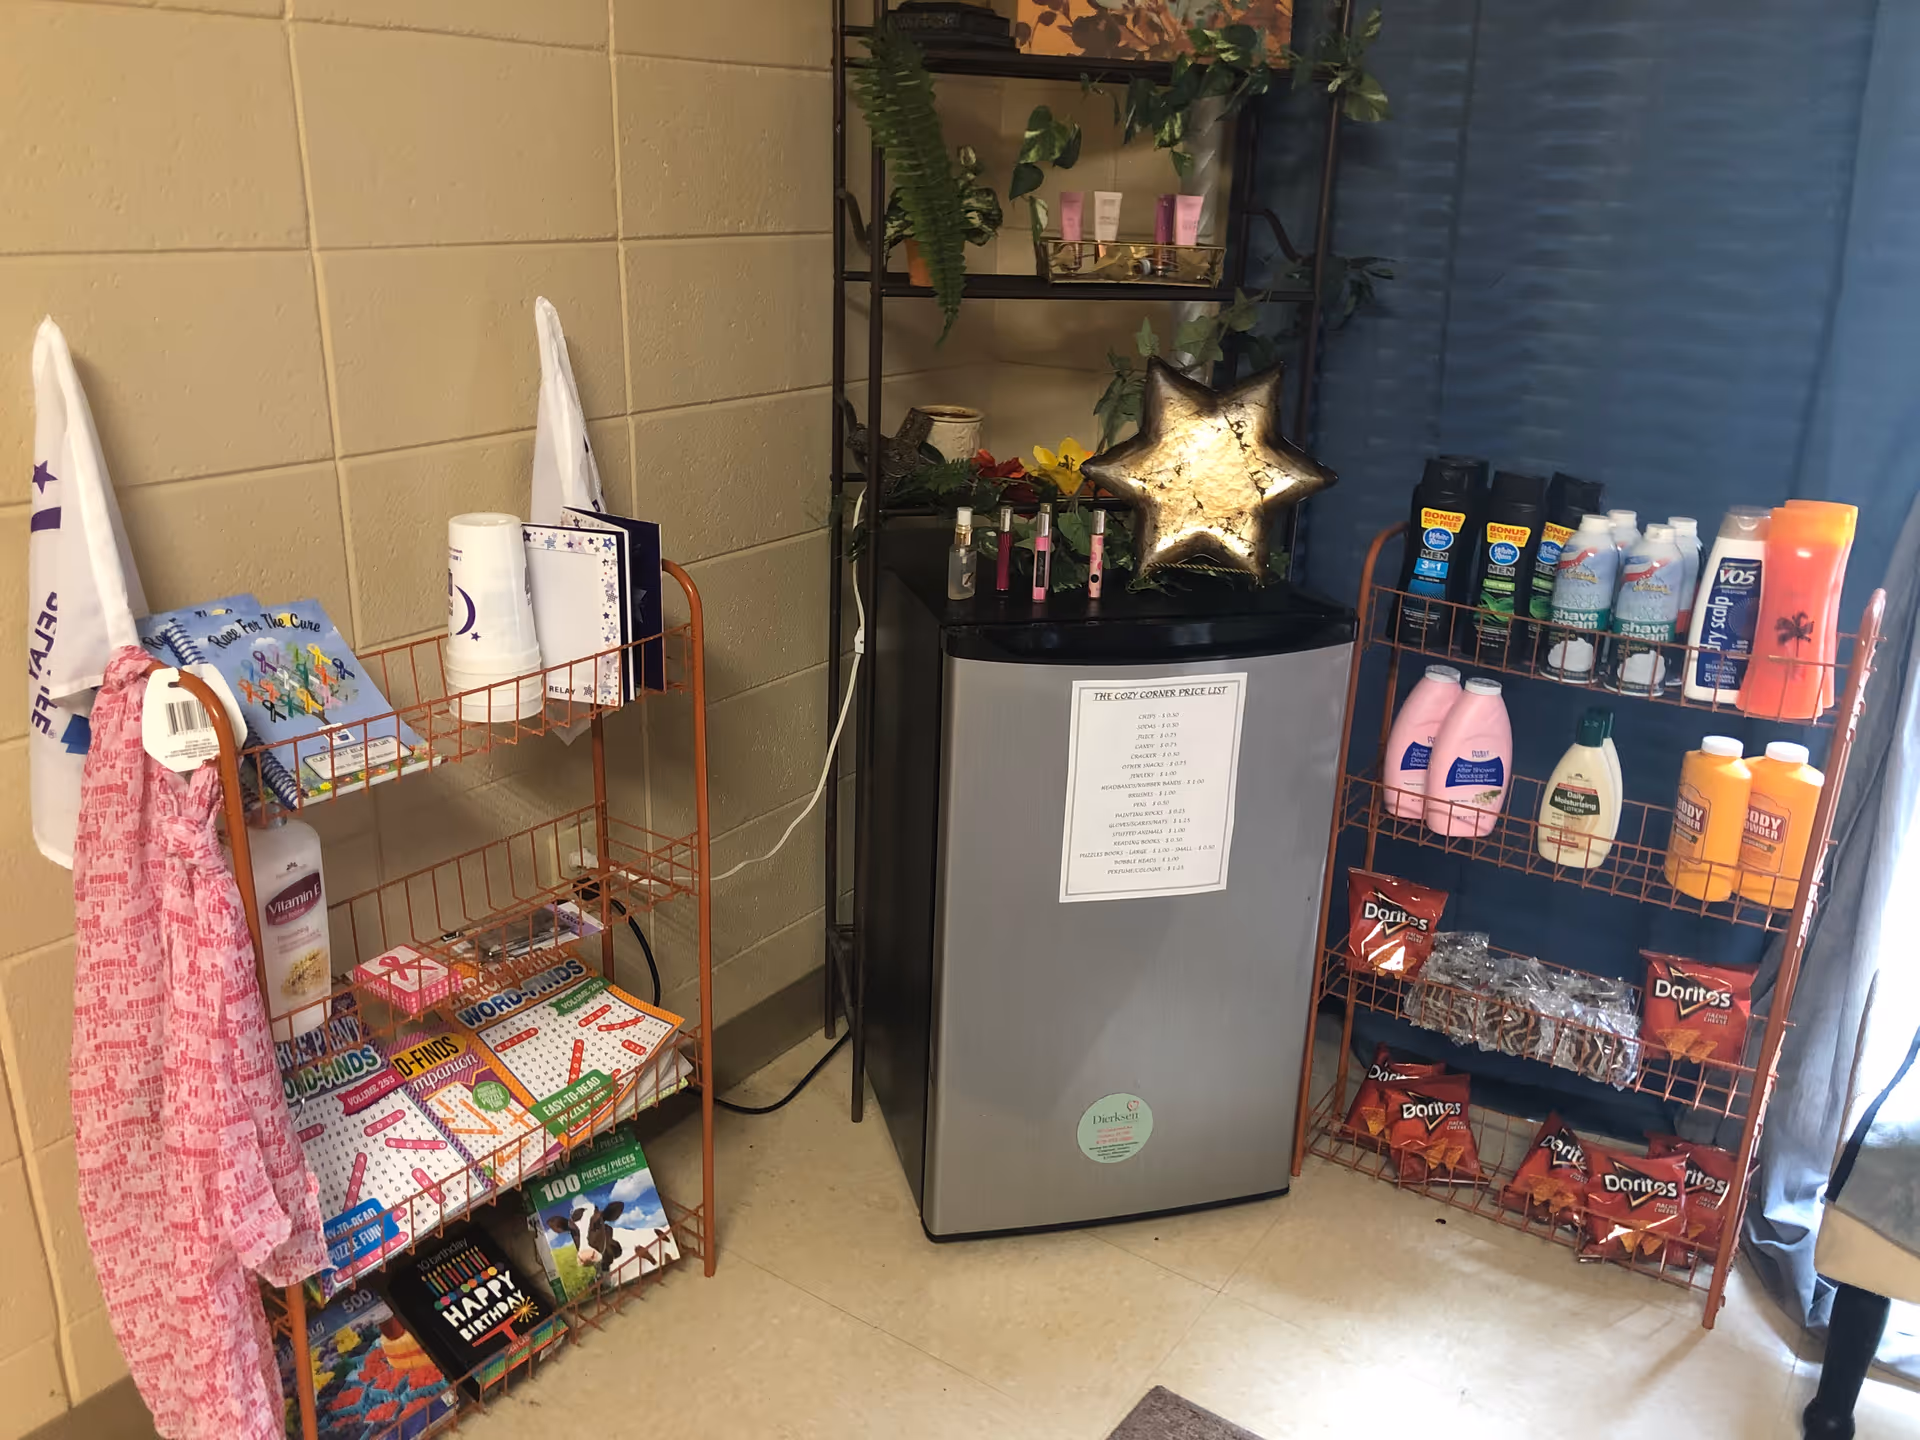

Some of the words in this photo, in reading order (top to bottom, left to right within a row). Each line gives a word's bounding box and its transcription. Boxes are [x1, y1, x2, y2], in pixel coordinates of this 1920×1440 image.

[1424, 510, 1462, 522] BONUS
[1423, 518, 1439, 527] 20%
[1440, 520, 1460, 530] FREE!
[1489, 526, 1527, 537] BONUS
[1544, 525, 1576, 538] ONUS
[1428, 531, 1450, 541] White
[1505, 534, 1525, 543] FREE!
[1421, 549, 1449, 561] MEN
[1494, 546, 1515, 556] White
[1488, 564, 1515, 576] MEN
[1720, 569, 1757, 584] VO5
[1553, 609, 1599, 621] shave
[1707, 596, 1734, 629] scalp
[208, 628, 242, 649] Race
[235, 618, 263, 635] For
[260, 613, 286, 629] The
[290, 613, 321, 632] Cure
[1622, 622, 1670, 633] shave
[1704, 673, 1711, 682] 5
[549, 685, 576, 695] RELAY
[1094, 692, 1113, 701] THE
[1114, 691, 1139, 700] COZY
[1140, 689, 1176, 699] CORNER
[1179, 687, 1206, 697] PRICE
[1208, 686, 1229, 695] LIST
[1130, 752, 1157, 760] CRACKER
[1554, 795, 1597, 811] Moisturizing
[1567, 791, 1585, 801] Daily
[1115, 811, 1143, 819] PAINTING
[1563, 805, 1584, 814] LOTION
[1744, 822, 1778, 840] OWDER
[1113, 839, 1140, 847] READING
[1079, 851, 1103, 859] PUZZLES
[268, 889, 313, 914] Vitamin
[313, 881, 320, 896] E
[1364, 902, 1429, 931] Doritos
[457, 959, 586, 1028] WORD-FINDS
[560, 989, 590, 1009] VOLUME
[1655, 979, 1732, 1007] Doritos
[393, 1036, 459, 1077] D-FINDS
[413, 1053, 478, 1092] mpanion
[347, 1084, 379, 1105] VOLUME
[378, 1076, 396, 1089] 253
[542, 1076, 601, 1117] EASY-TO-READ
[1402, 1101, 1462, 1119] Doritos
[1092, 1112, 1139, 1124] Dierksen
[581, 1164, 607, 1180] PIECES
[540, 1174, 580, 1202] 100
[1604, 1174, 1678, 1198] Doritos
[1684, 1168, 1728, 1195] ritos
[417, 1260, 430, 1272] 10
[428, 1238, 468, 1265] birthday
[342, 1290, 372, 1314] 500
[442, 1269, 515, 1328] HAPPY
[459, 1289, 526, 1342] BIRTHDAY
